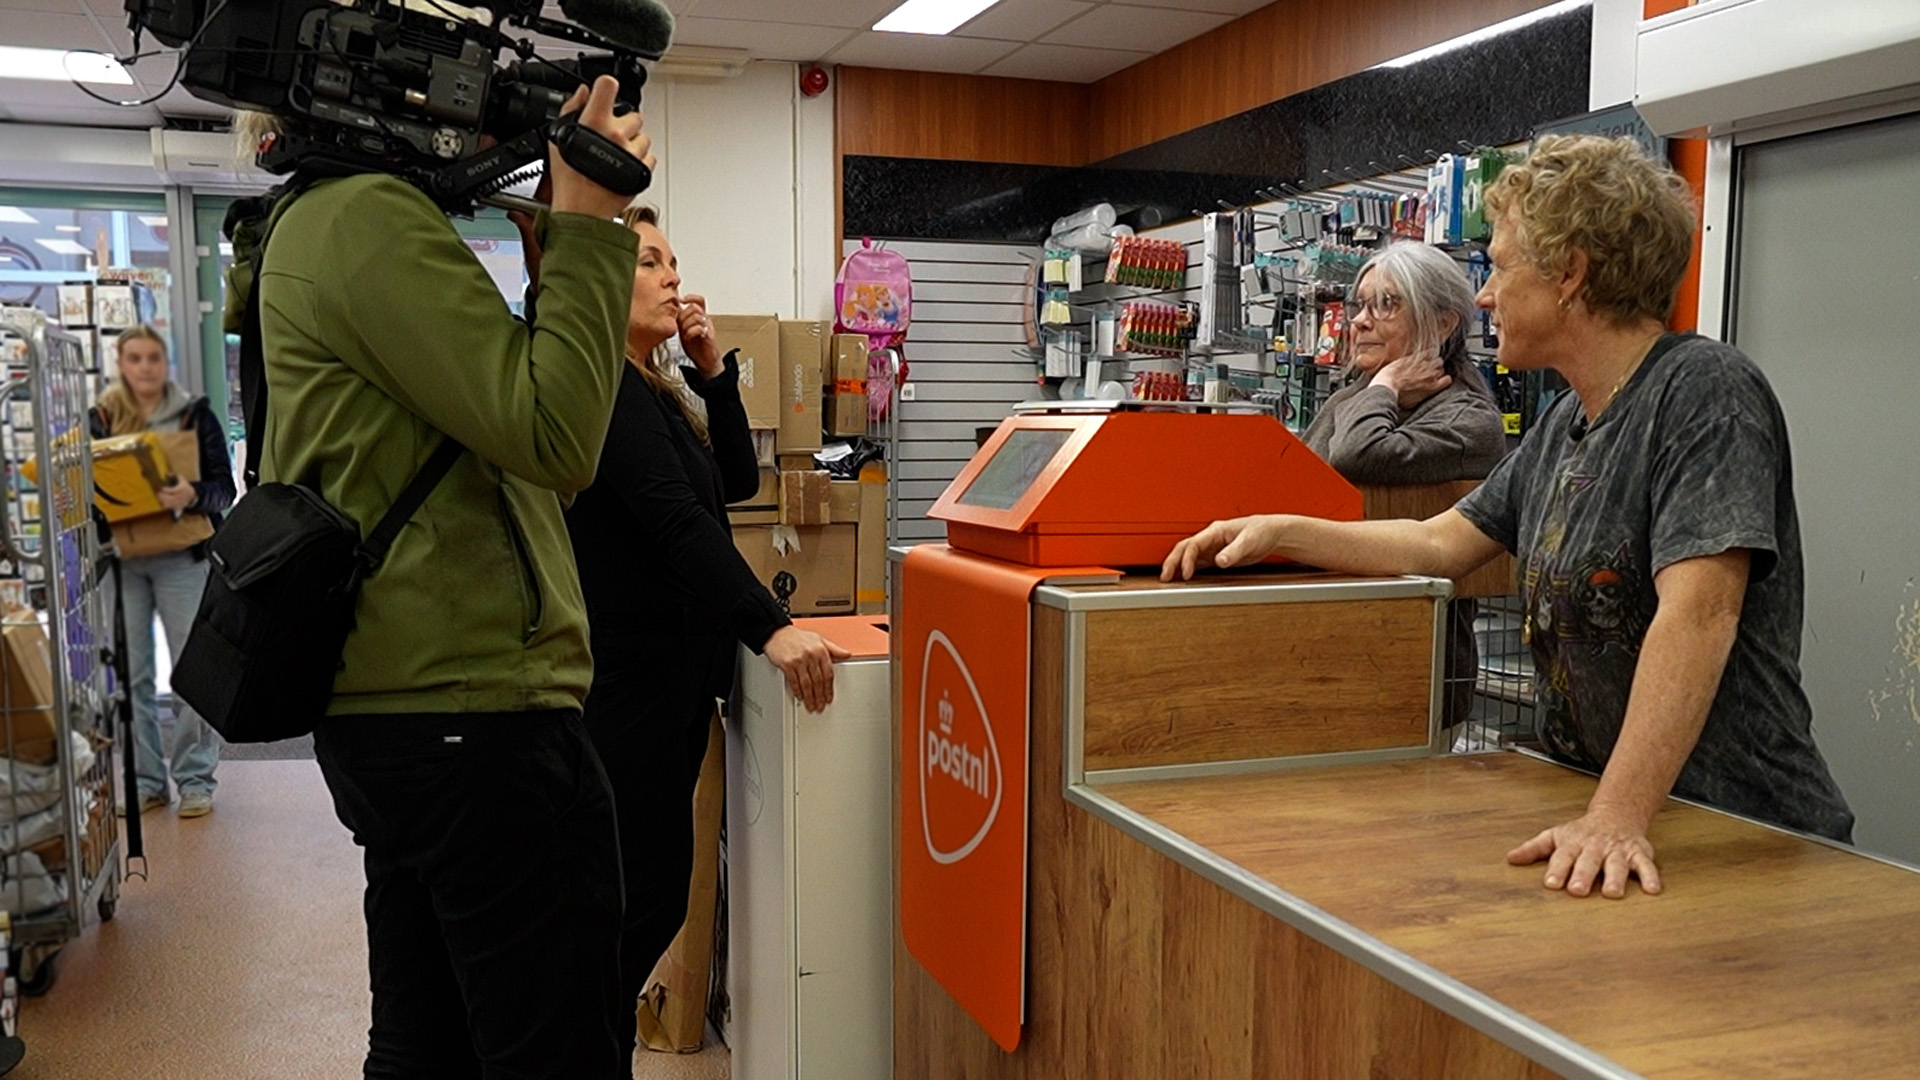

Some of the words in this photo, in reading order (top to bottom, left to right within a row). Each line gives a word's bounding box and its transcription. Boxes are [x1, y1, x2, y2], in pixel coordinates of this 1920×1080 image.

[466, 155, 500, 177] SONY
[589, 145, 624, 169] SONY
[793, 363, 803, 403] zalando
[927, 728, 990, 800] postnl
